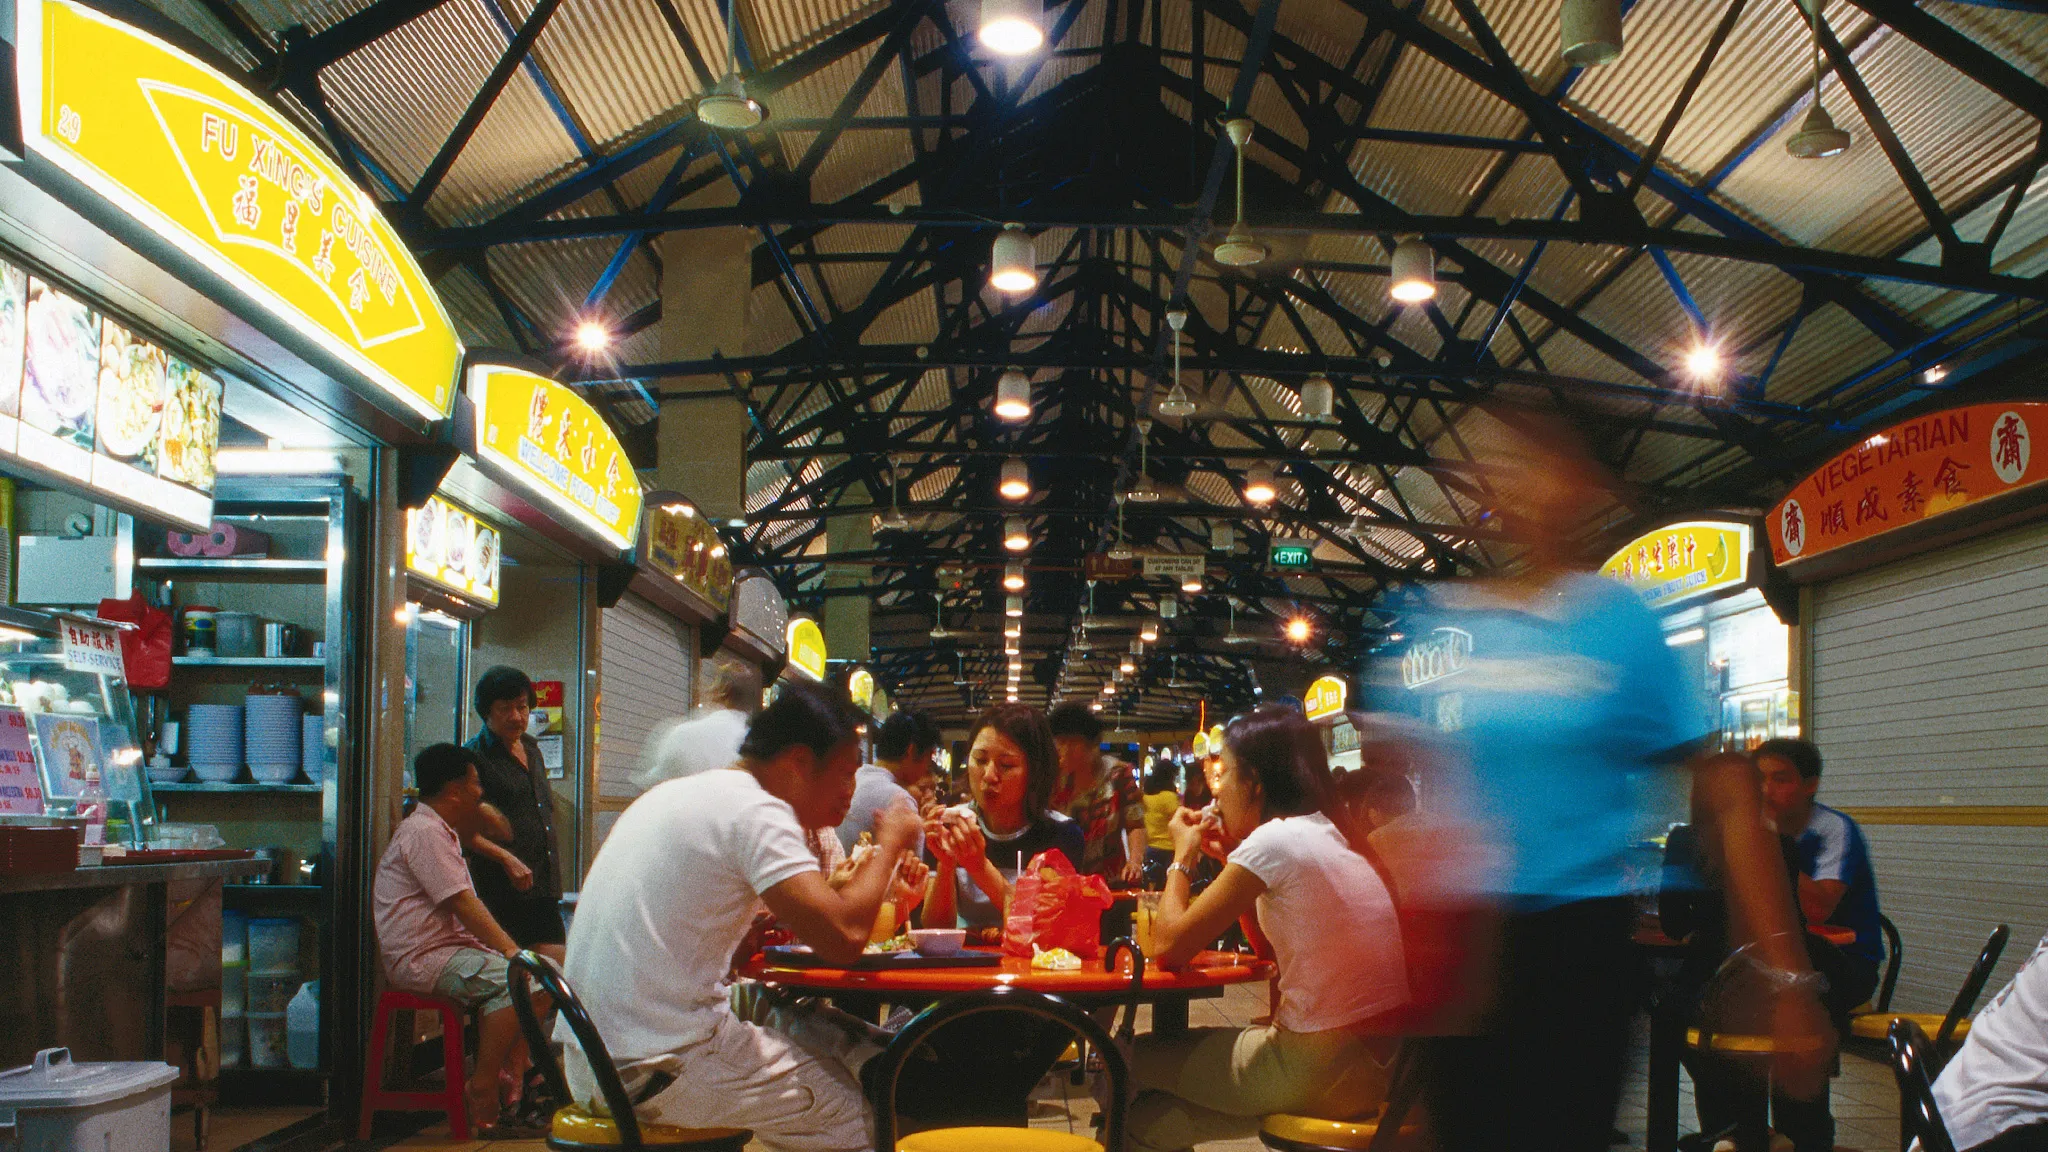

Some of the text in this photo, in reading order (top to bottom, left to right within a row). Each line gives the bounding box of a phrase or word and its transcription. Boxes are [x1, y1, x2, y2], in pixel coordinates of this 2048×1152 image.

[57, 104, 82, 143] 29
[202, 112, 238, 161] FU
[332, 202, 398, 307] CUISINE
[518, 435, 570, 489] WELCOME
[568, 475, 597, 513] FOOD
[1813, 411, 1969, 498] VEGETARIAN
[1820, 456, 1971, 537] 順成素食
[1280, 552, 1302, 565] EXIT
[1663, 578, 1683, 597] FRUIT
[1685, 569, 1706, 590] JUICE
